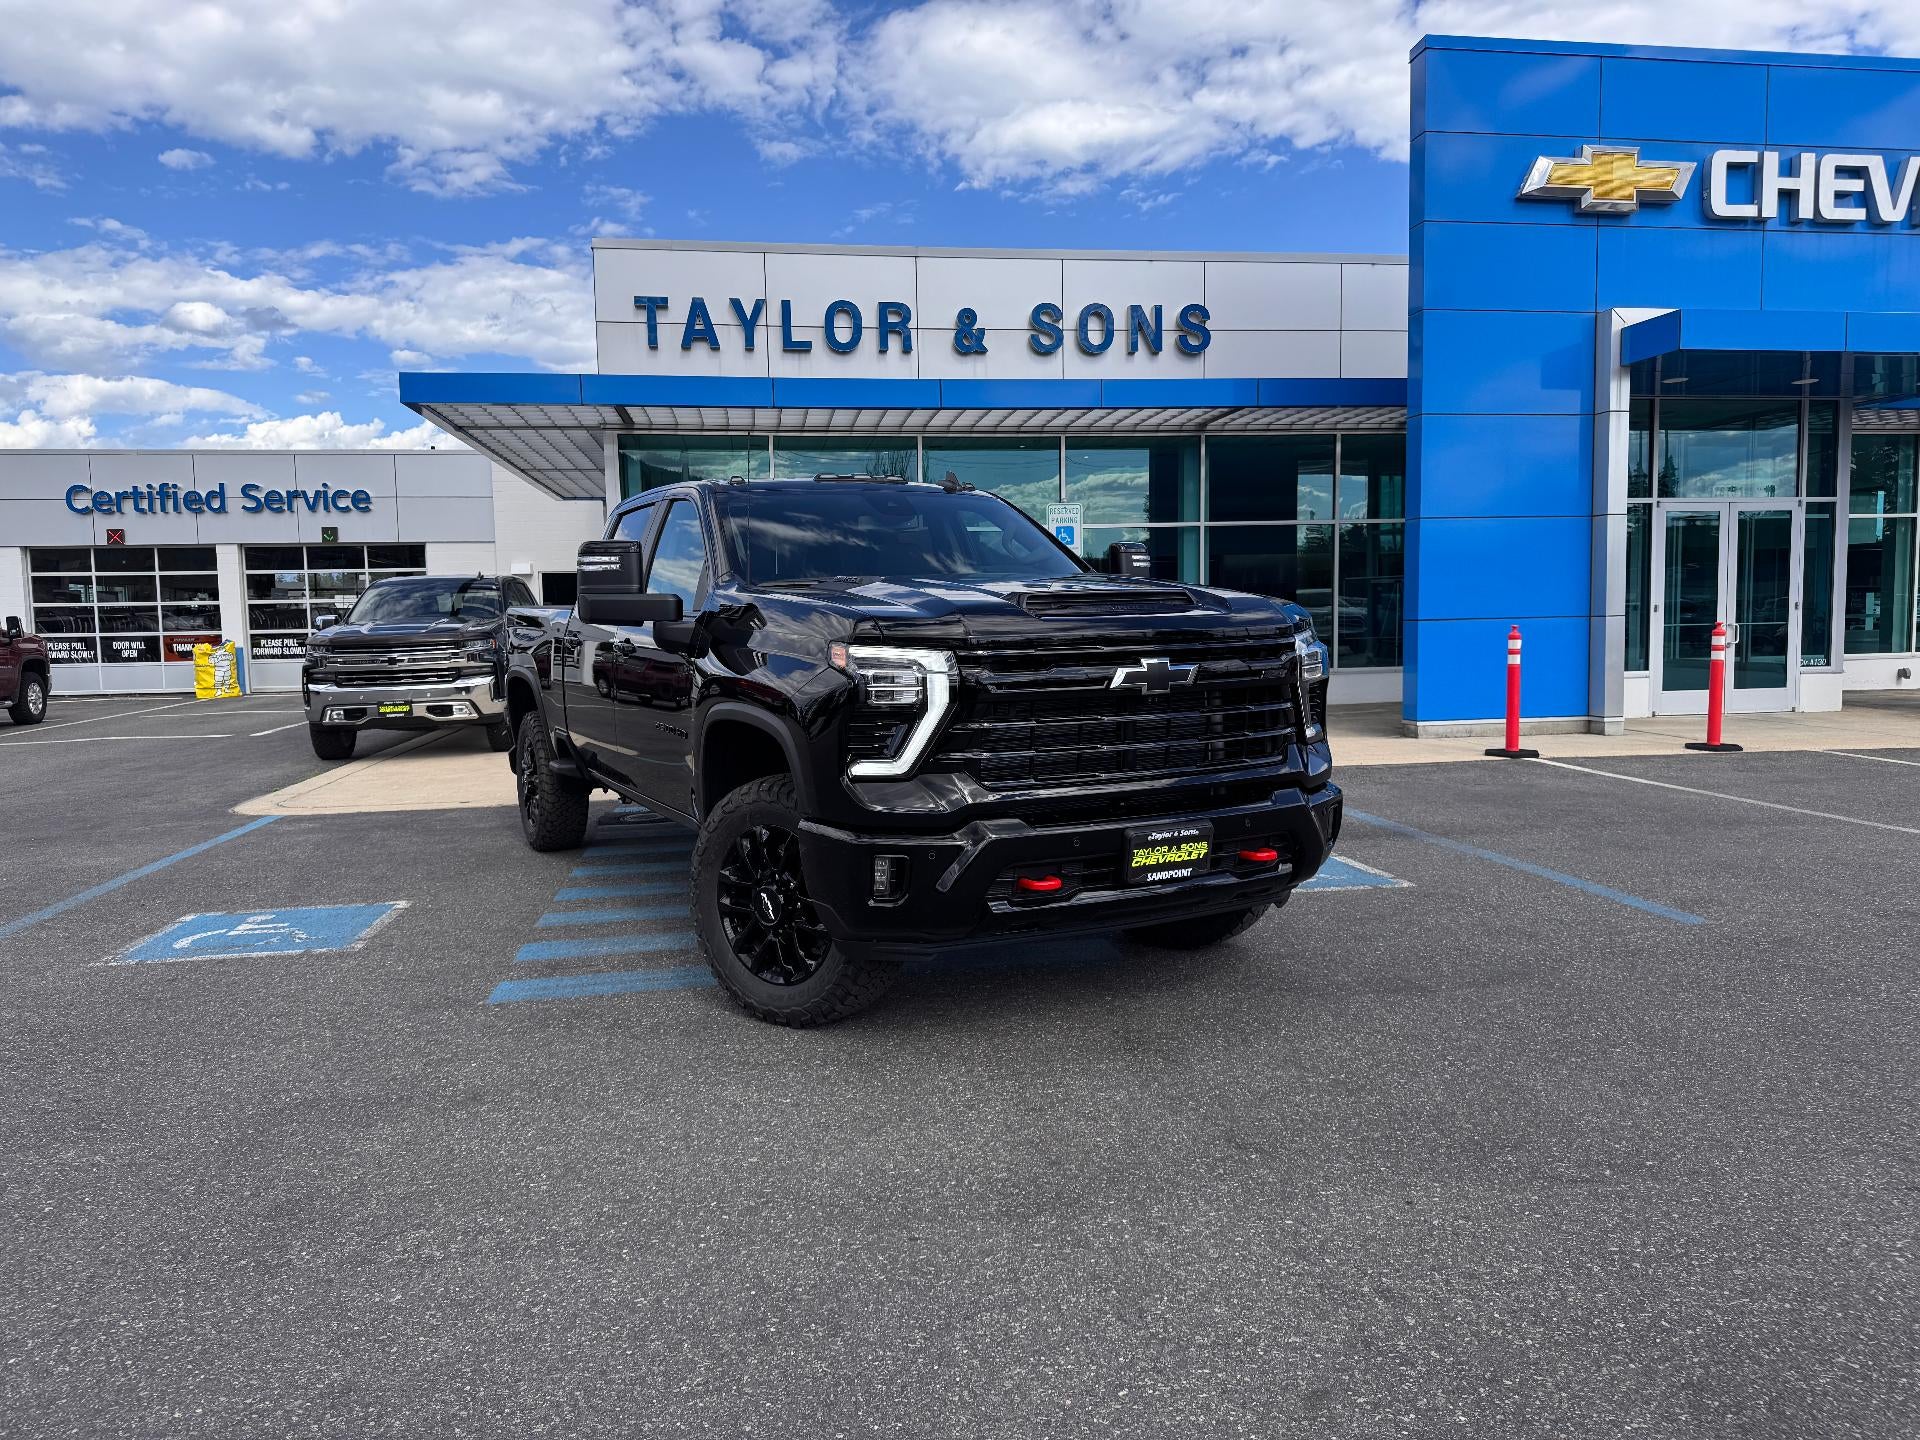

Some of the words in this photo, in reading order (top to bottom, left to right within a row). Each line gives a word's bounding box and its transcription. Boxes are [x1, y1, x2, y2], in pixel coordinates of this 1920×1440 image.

[1704, 149, 1920, 222] CHEV
[633, 295, 913, 354] TAYLOR
[953, 307, 988, 354] &
[1028, 302, 1212, 354] SONS
[65, 482, 227, 514] Certified
[240, 482, 373, 513] Service
[47, 642, 71, 650] PLEASE
[71, 641, 87, 650] PULL
[112, 641, 130, 650] DOOR
[130, 641, 147, 649] WILL
[260, 639, 283, 647] PLEASE
[283, 638, 299, 647] PULL
[48, 650, 70, 659] WARD
[70, 650, 95, 659] SLOWLY
[121, 650, 138, 658] OPEN
[252, 647, 282, 656] FORWARD
[282, 646, 307, 655] SLOWLY
[1133, 846, 1168, 857] TAYLOR
[1170, 845, 1178, 854] &
[1180, 841, 1209, 852] SONS
[1131, 850, 1208, 867] CHEVROLET
[1147, 868, 1192, 881] SANDPOINT
